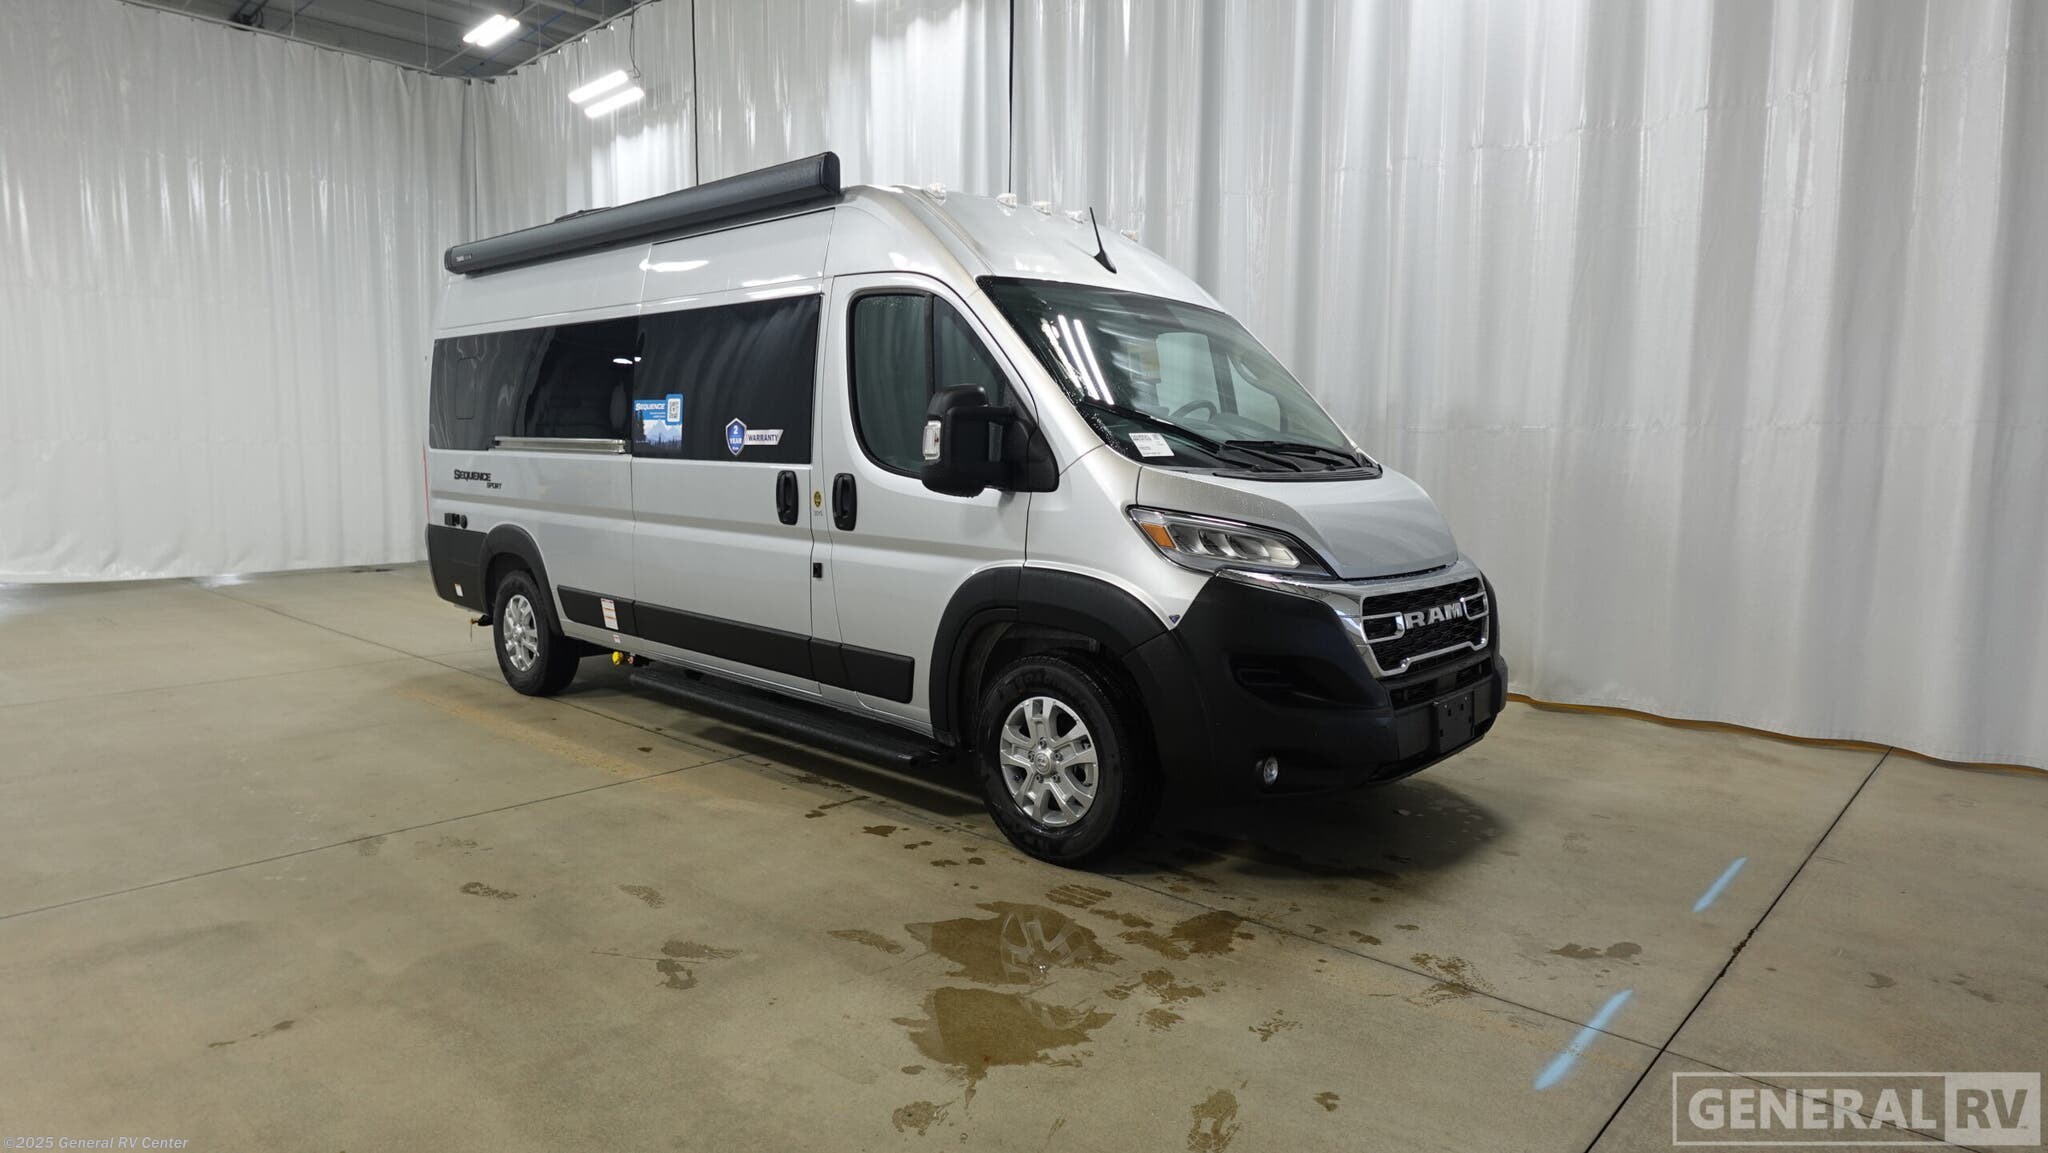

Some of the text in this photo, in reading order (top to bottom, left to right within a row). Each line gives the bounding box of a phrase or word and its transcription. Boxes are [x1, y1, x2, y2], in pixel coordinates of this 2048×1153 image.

[733, 425, 739, 434] 2
[454, 469, 491, 482] SEQUENCE
[1403, 602, 1463, 629] RAM
